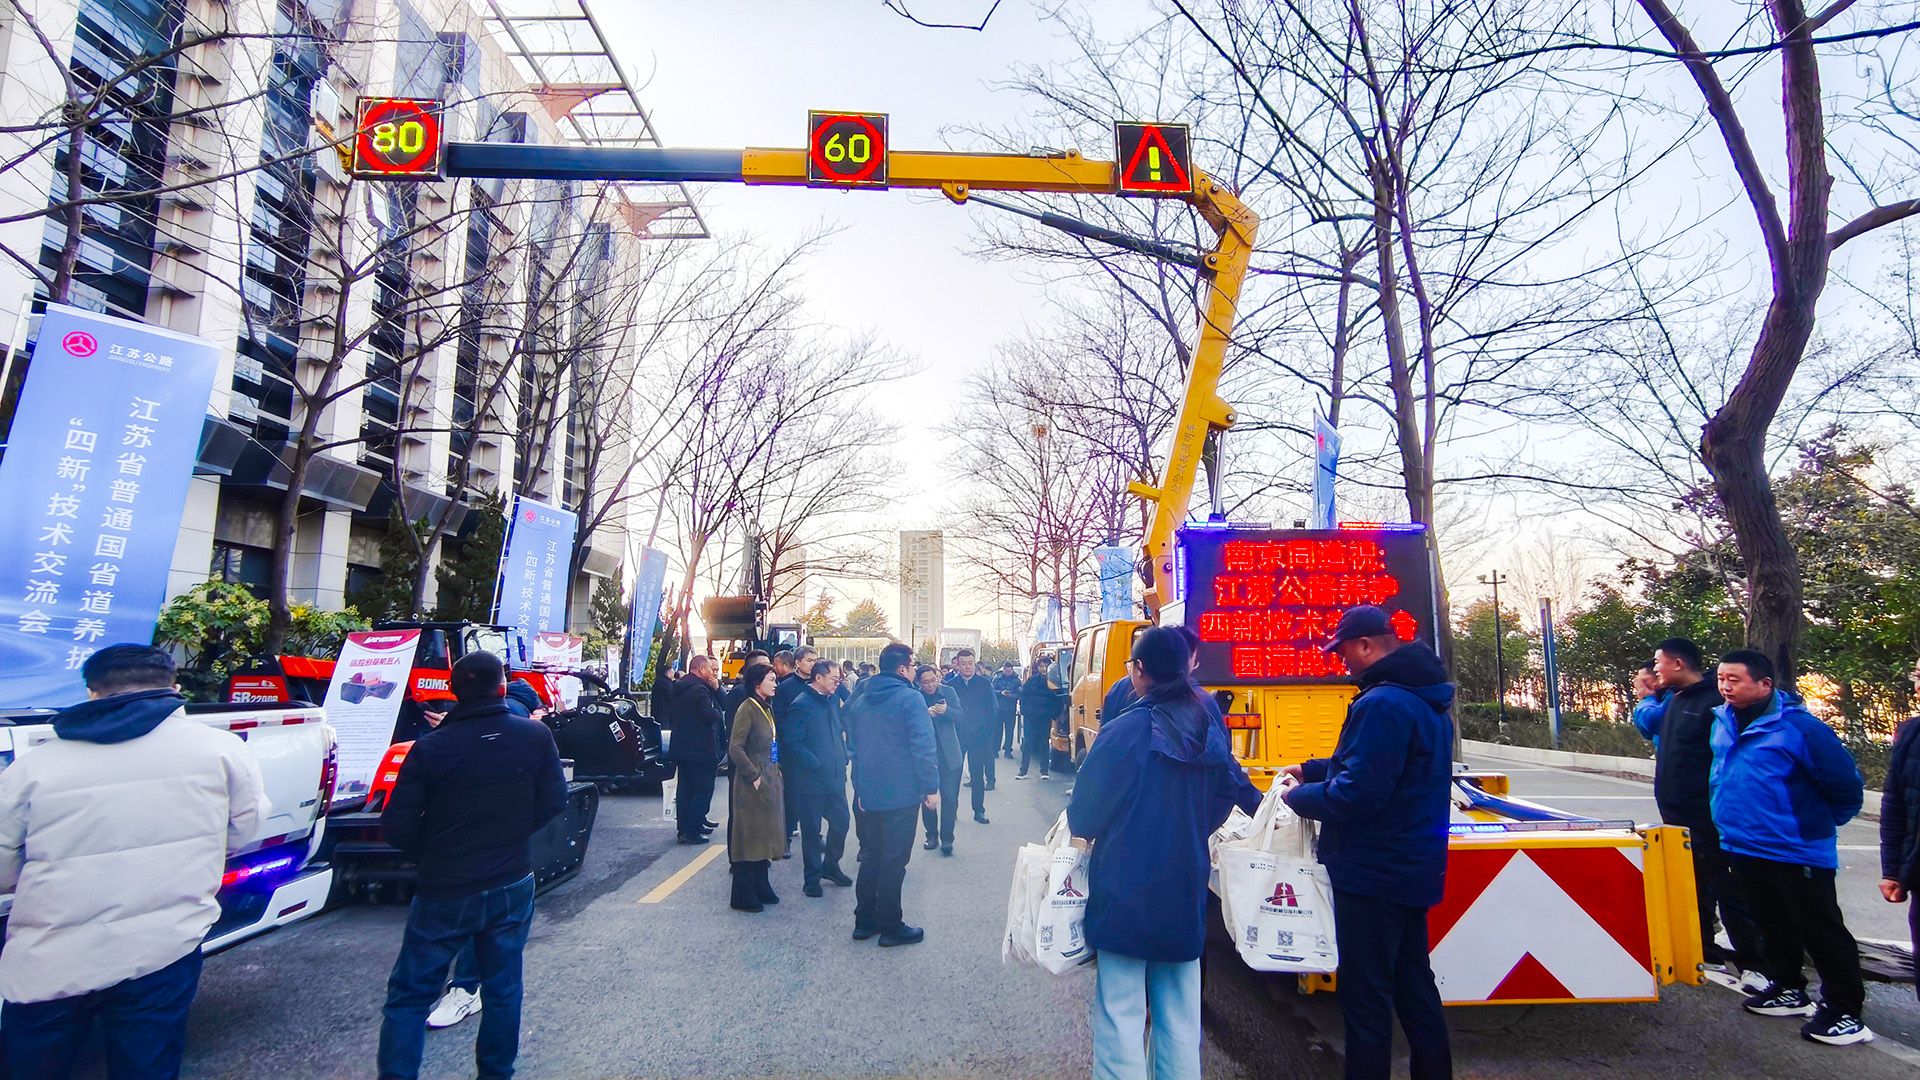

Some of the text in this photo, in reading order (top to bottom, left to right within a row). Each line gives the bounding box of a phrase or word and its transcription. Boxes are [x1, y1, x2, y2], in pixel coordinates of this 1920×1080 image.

[373, 121, 424, 153] 80
[825, 133, 870, 163] 60
[109, 343, 174, 367] 江苏公路
[65, 396, 161, 671] 江苏省普通国省道养护
